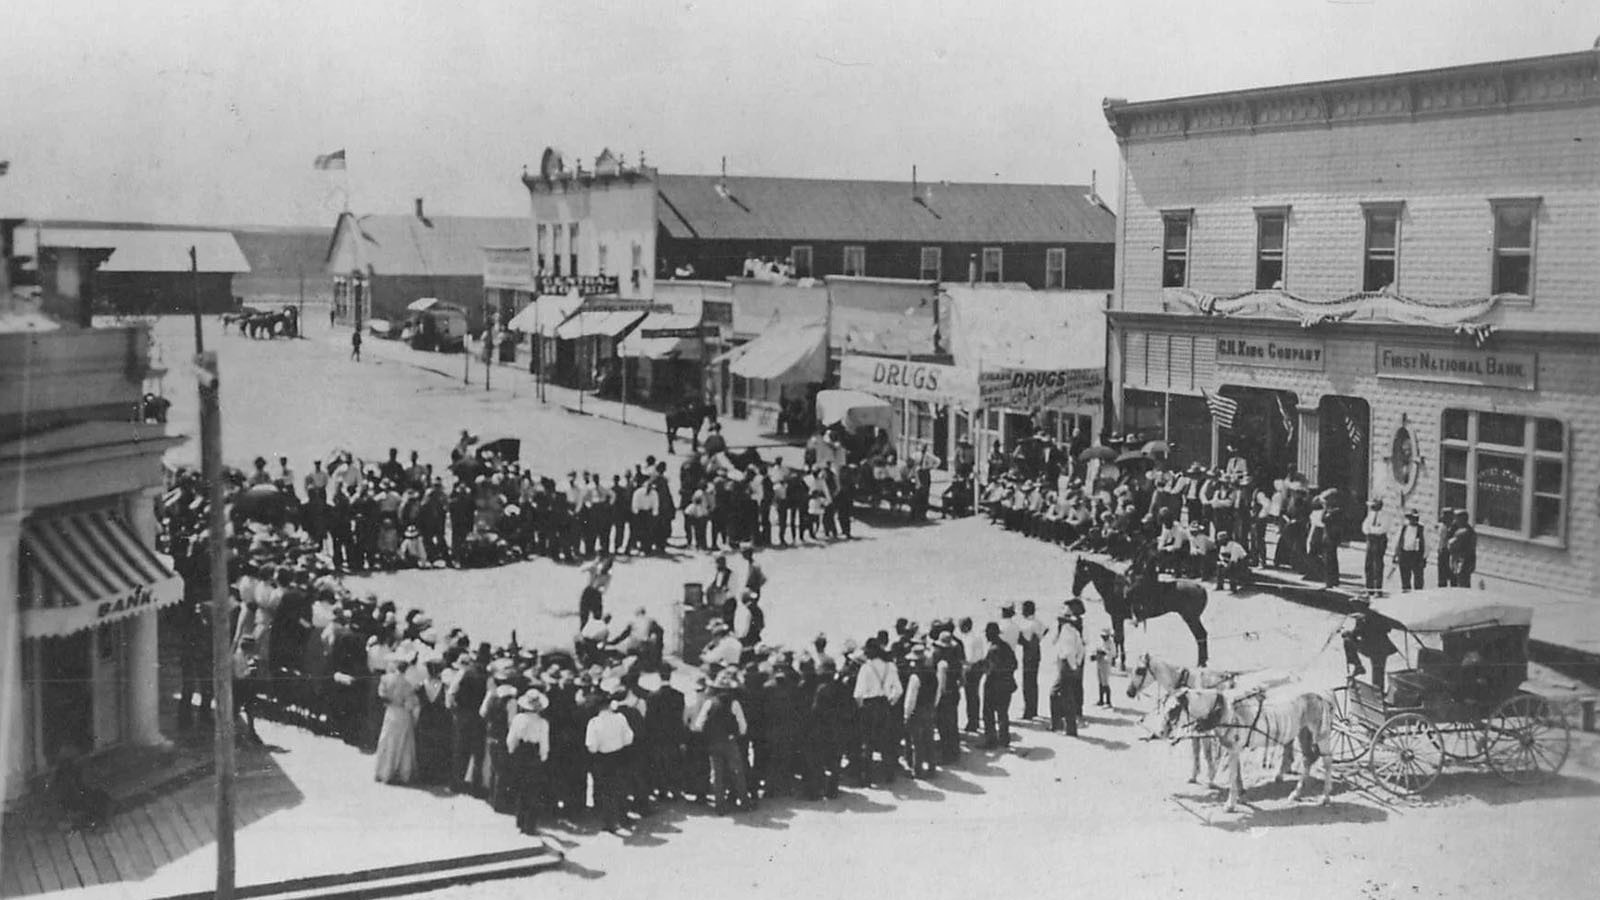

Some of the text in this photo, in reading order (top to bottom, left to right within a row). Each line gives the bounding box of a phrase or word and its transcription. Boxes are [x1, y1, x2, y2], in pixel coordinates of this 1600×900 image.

[1268, 342, 1321, 362] COMPANY
[1383, 350, 1417, 369] FIRST
[1419, 351, 1484, 375] NATIONAL
[872, 361, 941, 392] DRUGS
[1012, 371, 1067, 388] DRUGS
